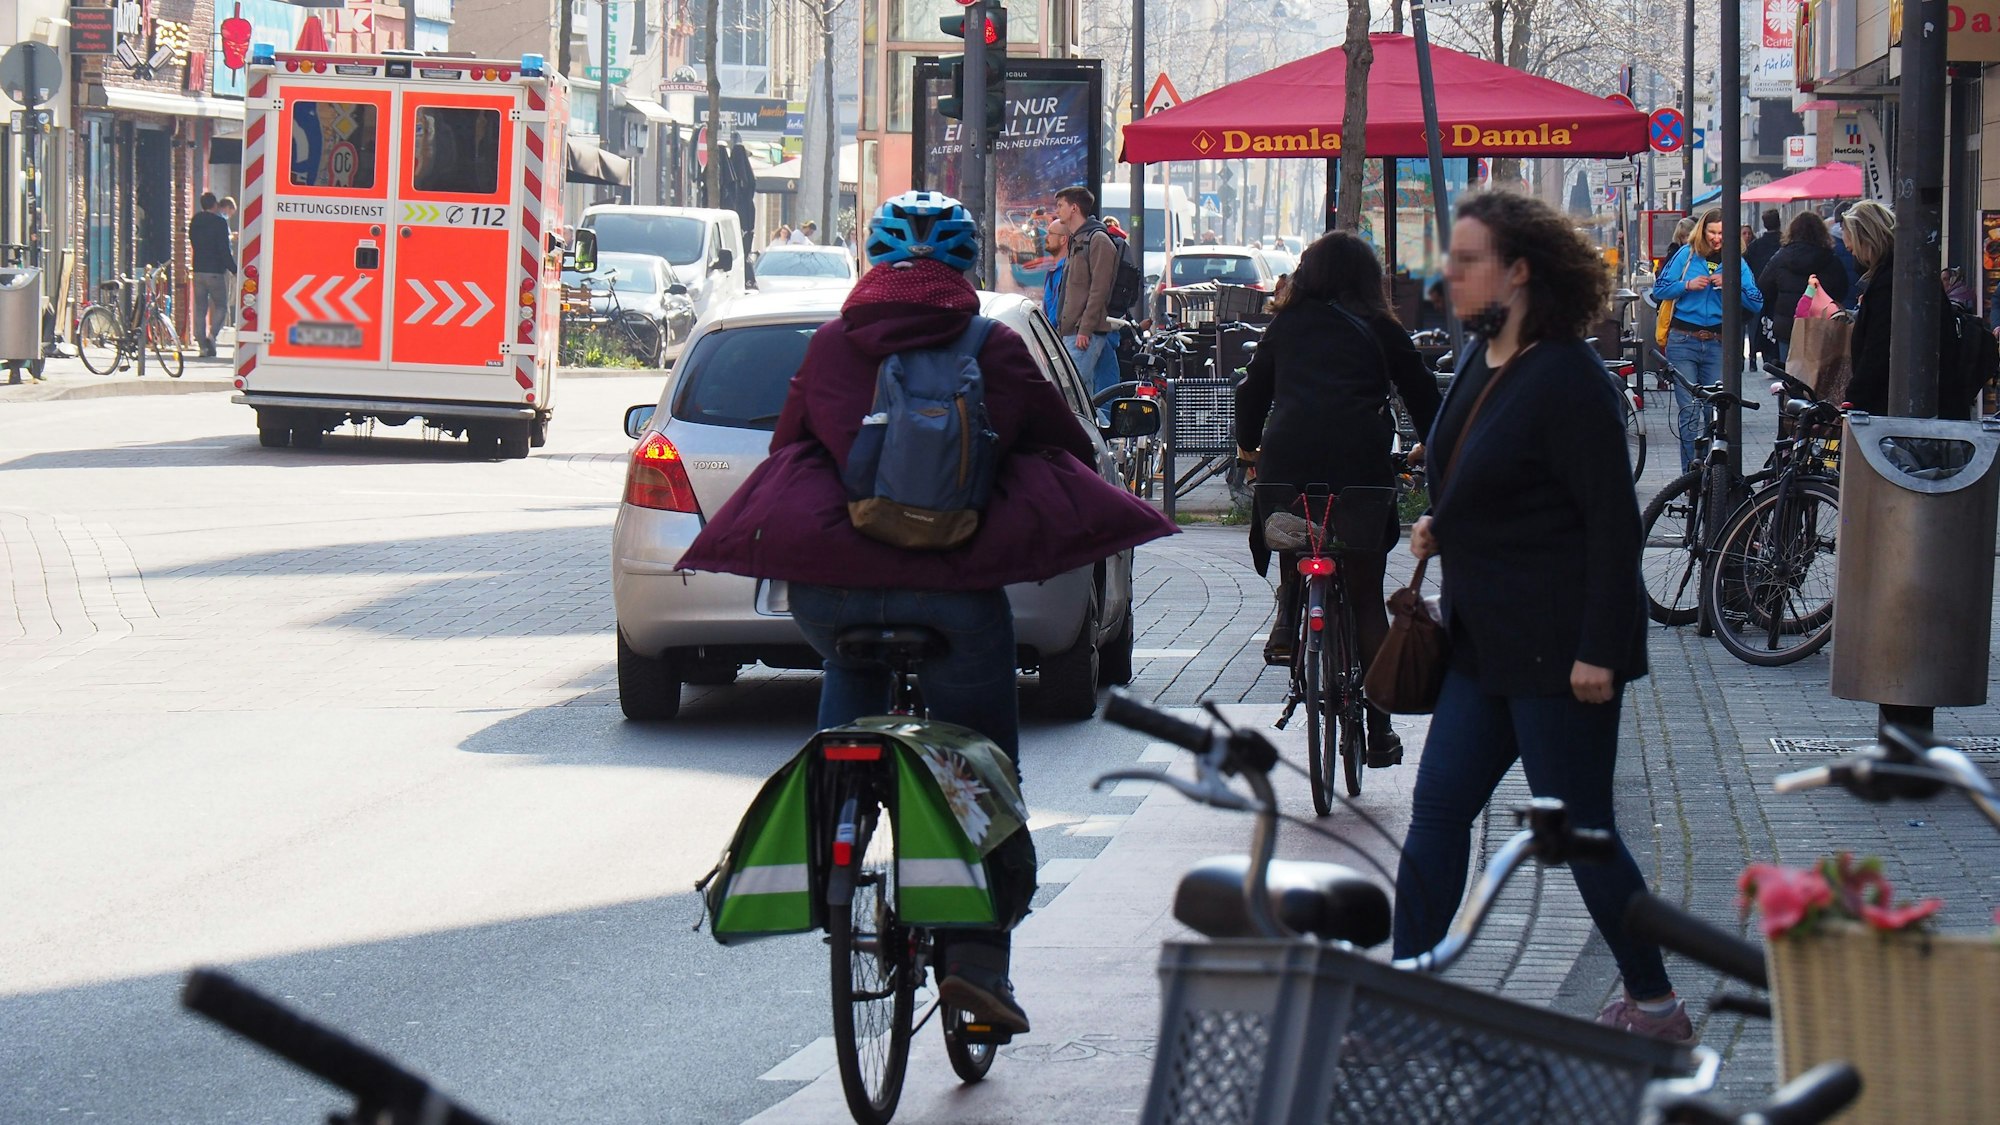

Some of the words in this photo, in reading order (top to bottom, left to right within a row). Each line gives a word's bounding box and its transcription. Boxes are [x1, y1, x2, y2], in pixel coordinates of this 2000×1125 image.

[1947, 5, 2000, 33] Da
[1014, 97, 1059, 117] NUR
[1025, 116, 1069, 136] LIVE
[1451, 123, 1572, 148] Damla
[931, 145, 953, 155] ALTE
[1011, 139, 1032, 149] NEU
[1222, 128, 1341, 153] Damla
[276, 201, 385, 217] RETTUNGSDIENST
[470, 206, 506, 227] 112
[693, 460, 730, 470] TOYOTA
